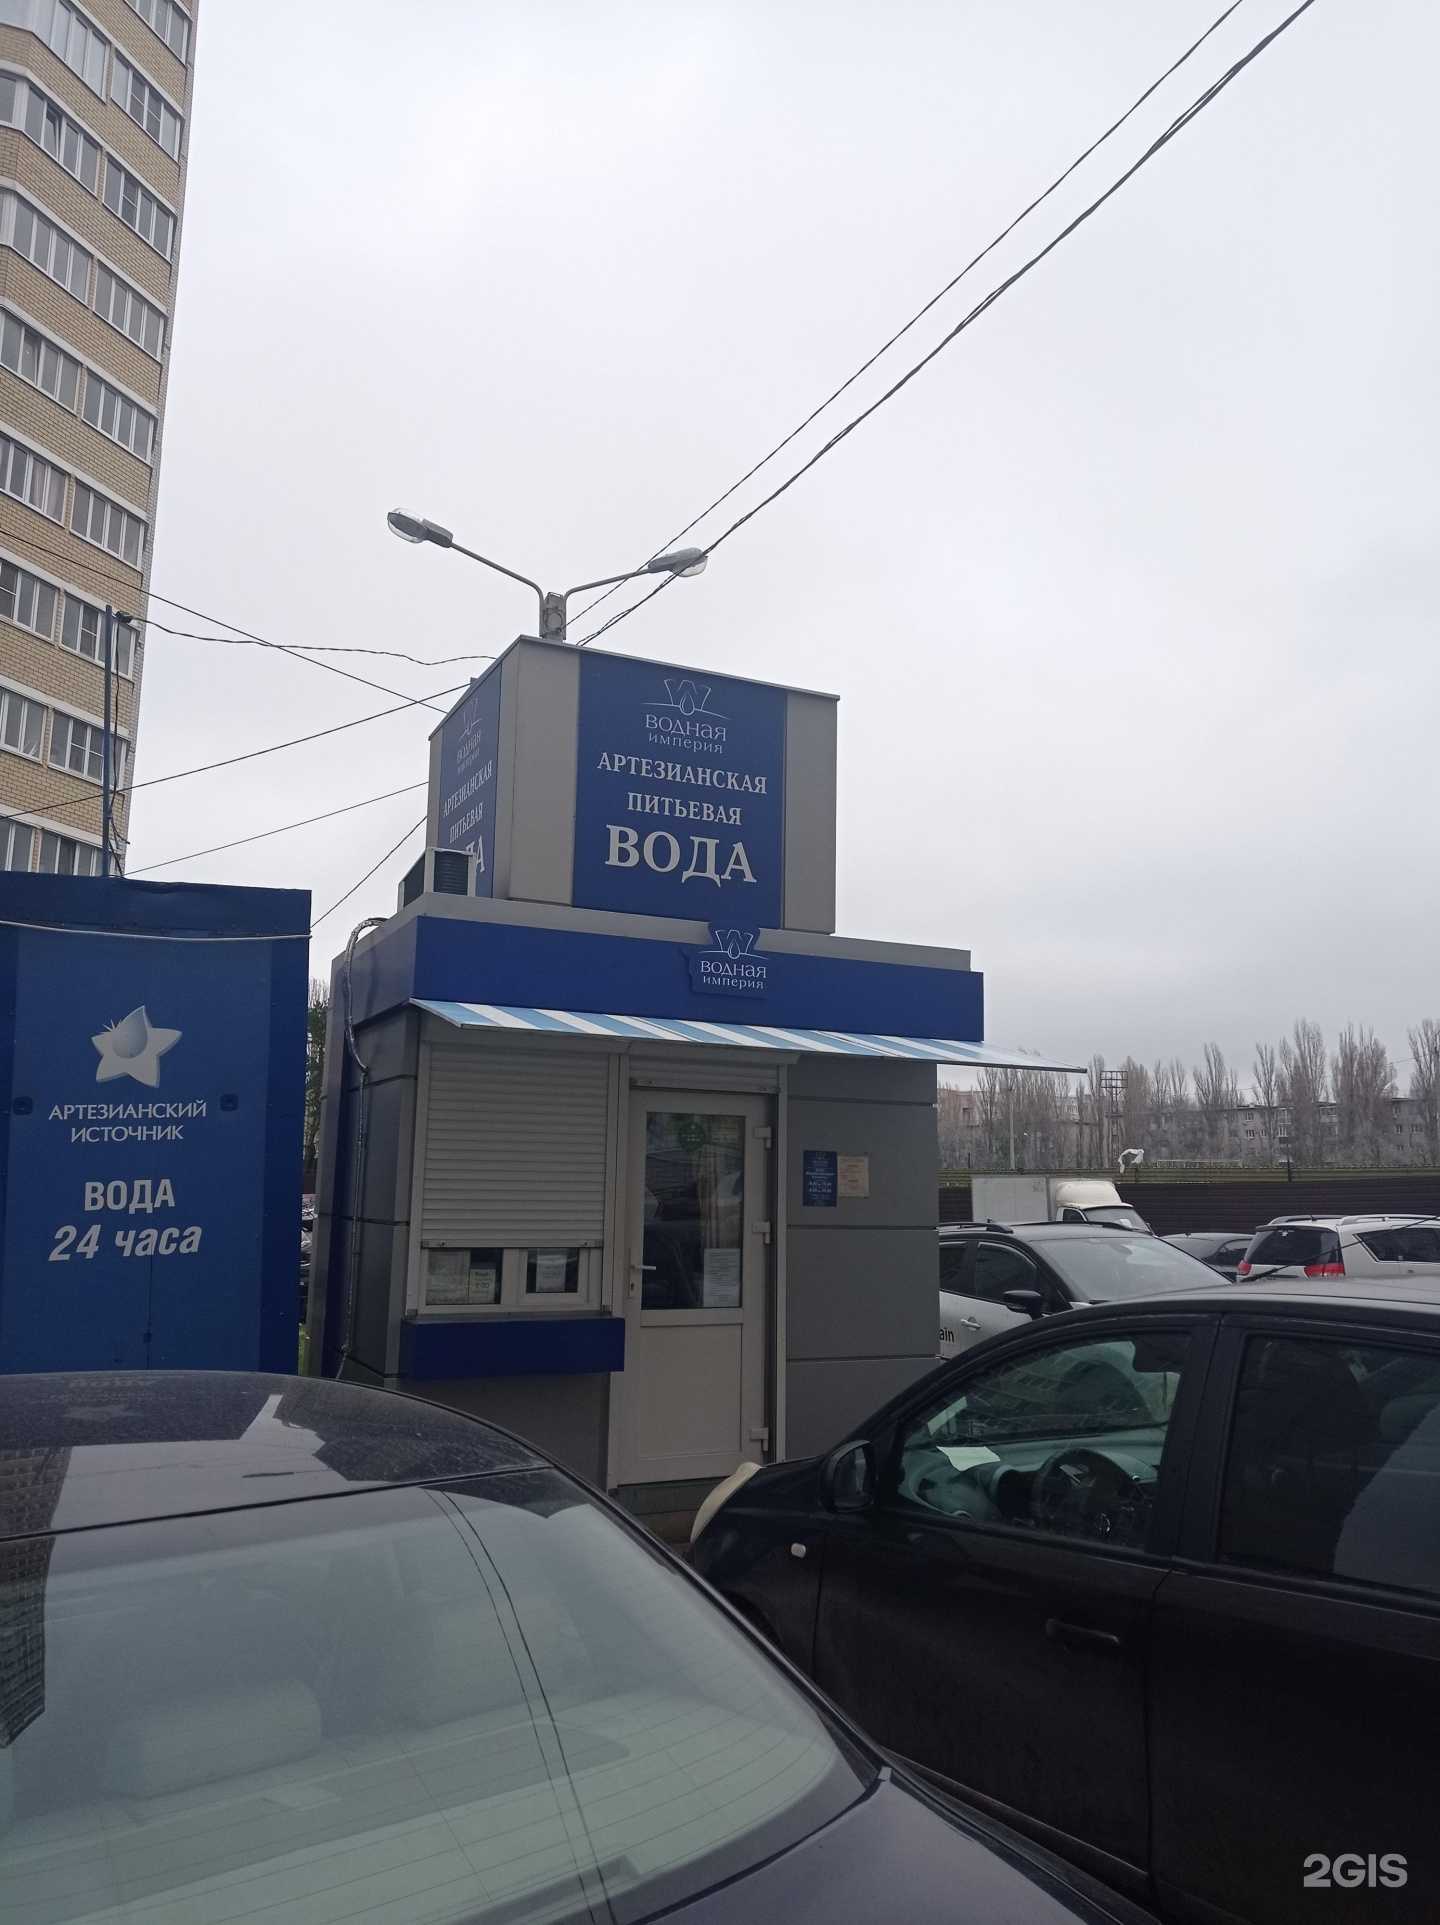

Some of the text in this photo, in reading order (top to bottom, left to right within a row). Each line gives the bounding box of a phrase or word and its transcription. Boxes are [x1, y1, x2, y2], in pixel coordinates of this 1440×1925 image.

[443, 760, 493, 818] АРТЕЗИАНСКАЯ
[597, 751, 768, 795] АРТЕЗИАНСКАЯ
[449, 802, 484, 844] ПИТЬЕВАЯ
[626, 791, 743, 826] ПИТЬЕВАЯ
[604, 824, 757, 888] ВОДА
[48, 1099, 207, 1121] АРТЕЗИАНСКИЙ
[71, 1125, 185, 1143] ИСТОЧНИК
[84, 1178, 176, 1215] ВОДА
[48, 1224, 203, 1262] 24 часа
[939, 1327, 955, 1343] ain
